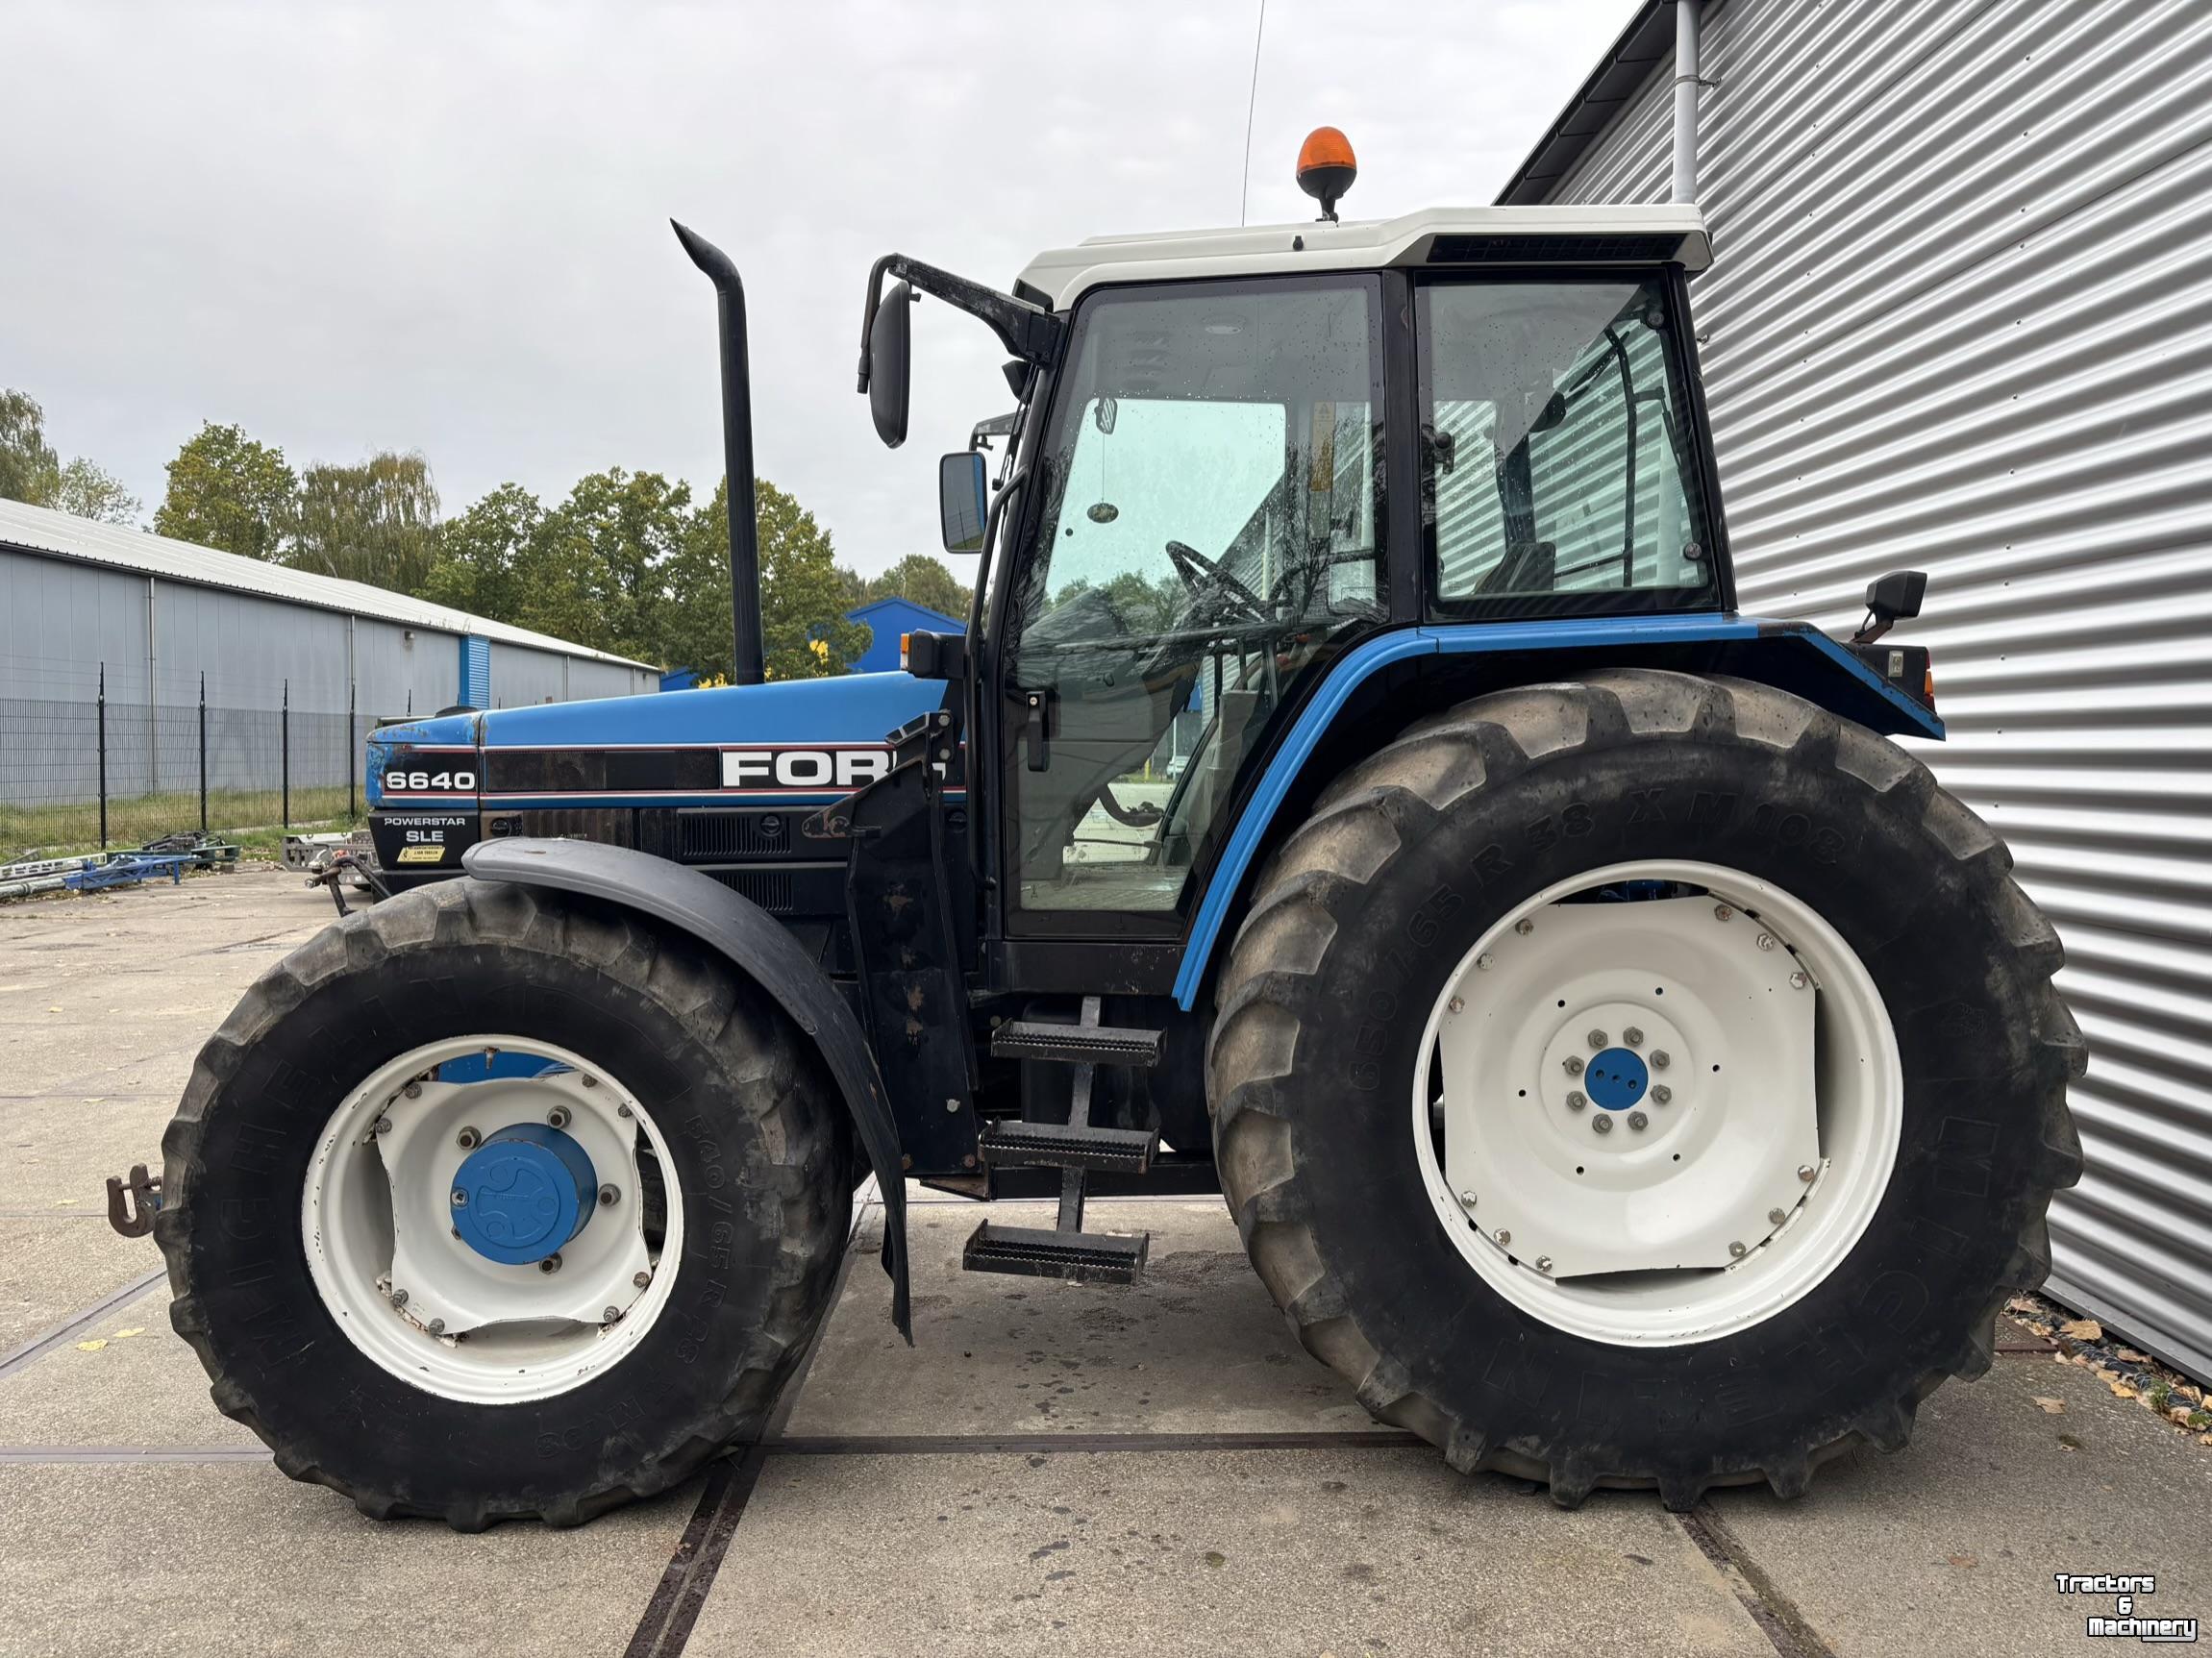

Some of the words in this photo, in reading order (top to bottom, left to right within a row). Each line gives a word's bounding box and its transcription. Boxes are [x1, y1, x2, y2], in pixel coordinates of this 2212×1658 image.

[722, 751, 947, 786] FOR
[386, 772, 475, 790] 6640
[385, 817, 465, 827] POWERSTAR
[406, 830, 444, 842] SLE
